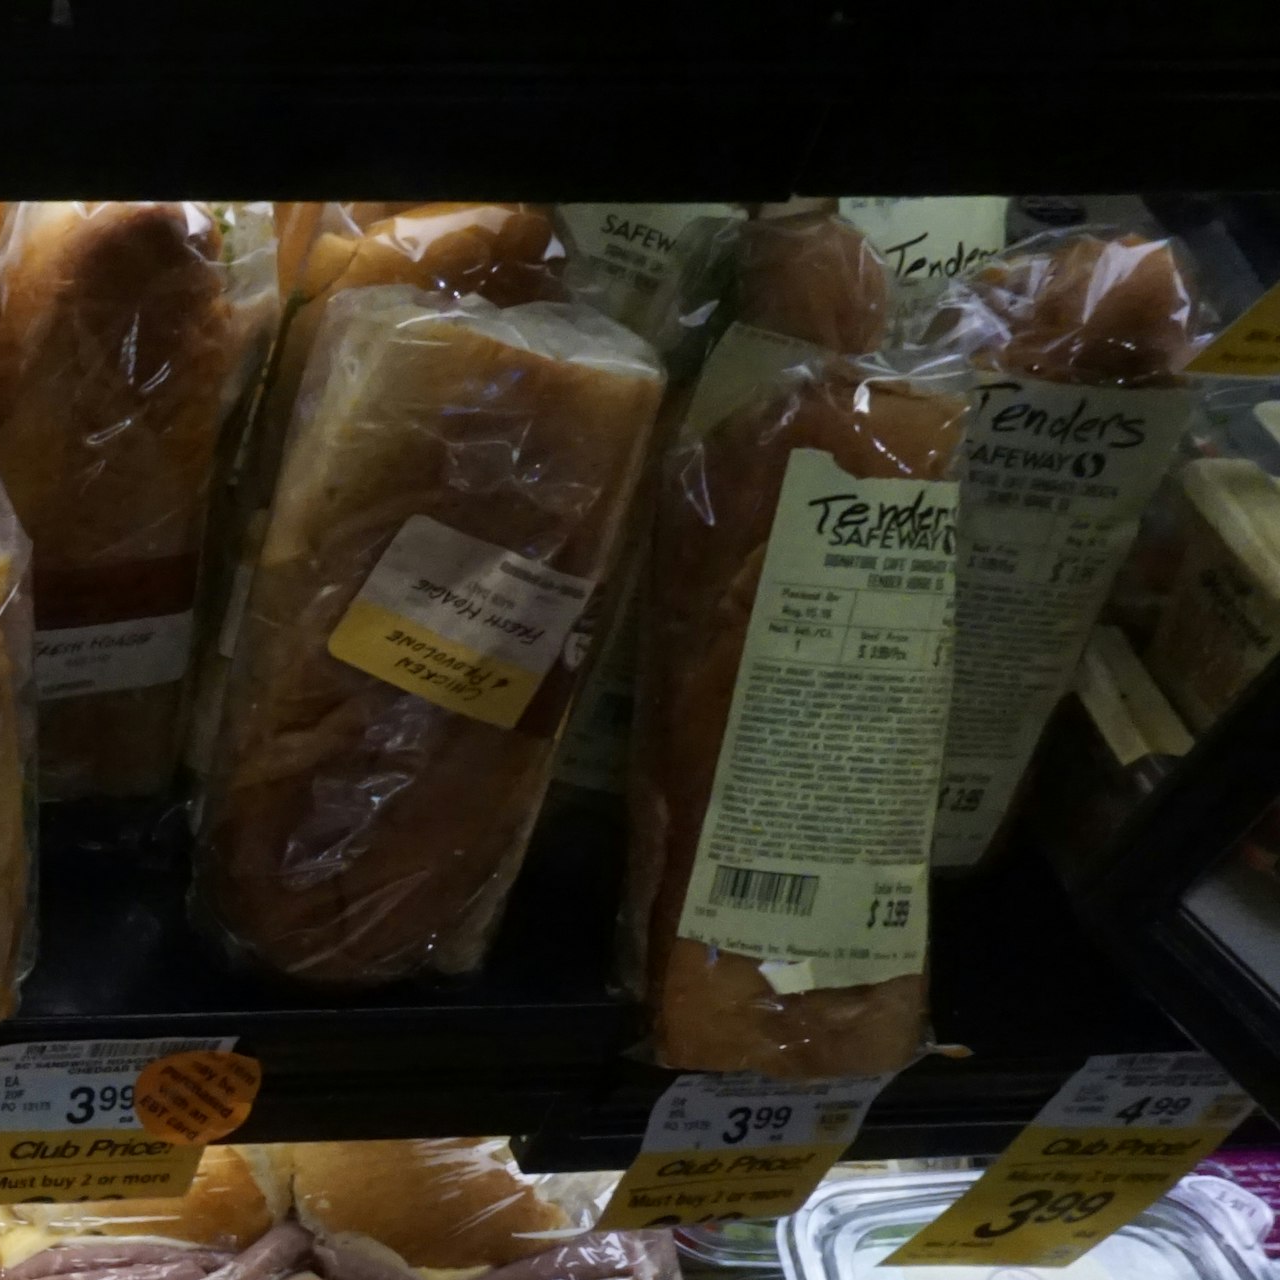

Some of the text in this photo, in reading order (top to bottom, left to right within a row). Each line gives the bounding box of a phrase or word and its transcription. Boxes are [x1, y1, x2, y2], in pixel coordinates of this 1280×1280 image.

[975, 383, 1146, 449] Tenders
[829, 526, 940, 550] SAFEWAY
[412, 580, 481, 621] HOAGIE
[485, 616, 544, 644] FRESH
[385, 629, 493, 685] PROVOLONE
[394, 657, 482, 701] CHICKEN
[4, 1076, 20, 1087] EA
[140, 1095, 169, 1117] EBT
[10, 1140, 80, 1160] Club
[657, 1158, 724, 1177] Club
[41, 1174, 76, 1190] buy
[81, 1174, 92, 1186] 2
[97, 1174, 118, 1185] or
[122, 1172, 170, 1184] more
